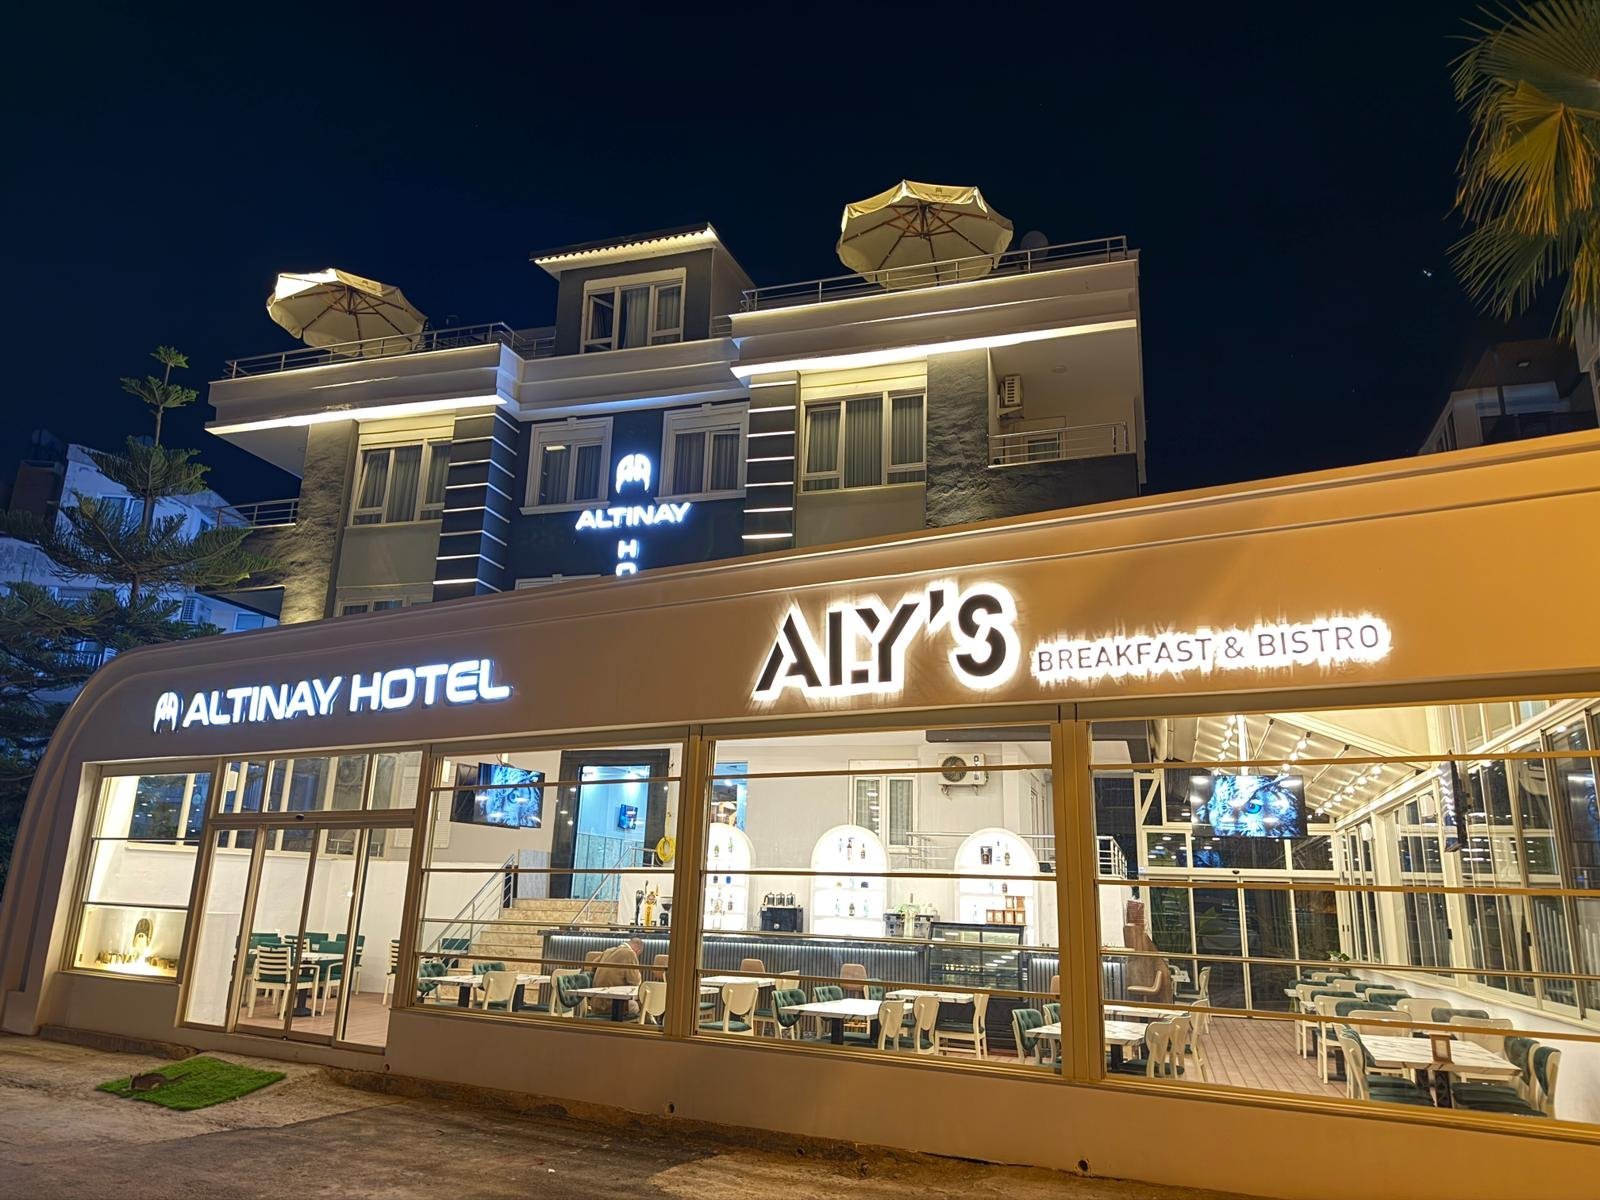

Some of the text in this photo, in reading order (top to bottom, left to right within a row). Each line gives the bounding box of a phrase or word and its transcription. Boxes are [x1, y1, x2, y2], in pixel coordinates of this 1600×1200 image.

[575, 502, 691, 530] ALTINAY
[755, 589, 1007, 692] ALY'S
[1037, 624, 1379, 672] BREAKFAST & BISTRO
[182, 660, 511, 727] ALTINAY HOTEL
